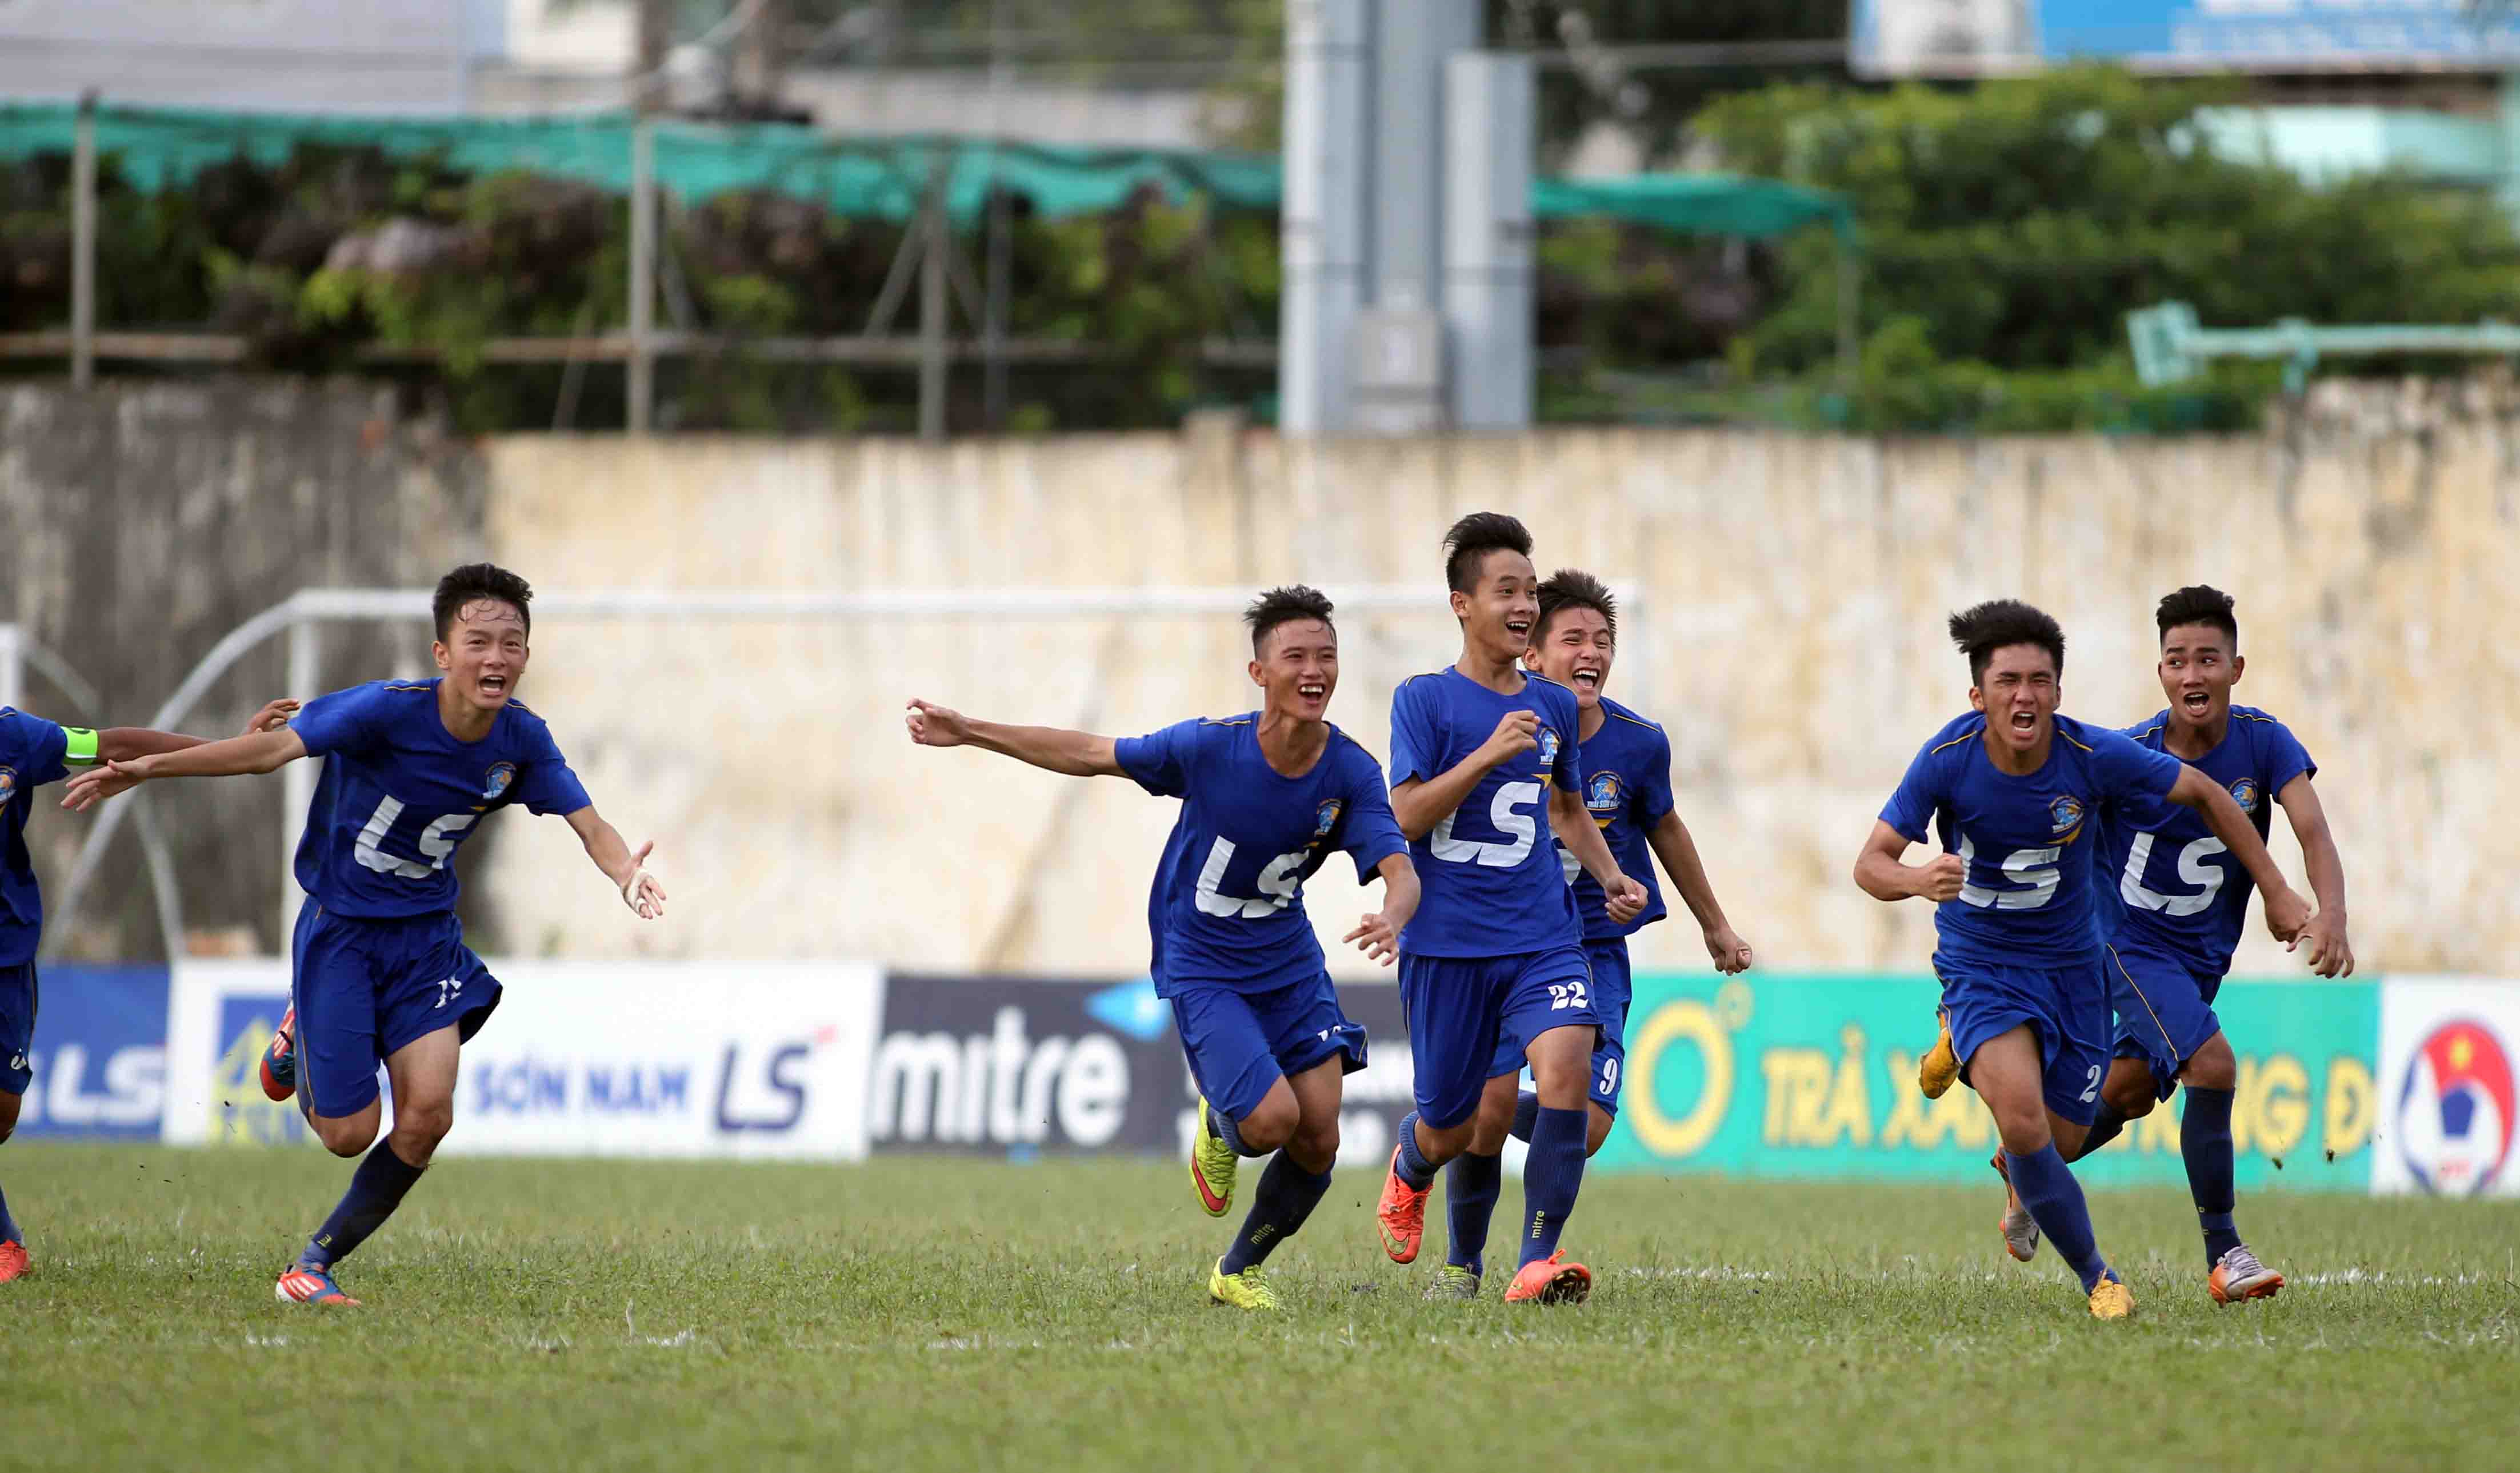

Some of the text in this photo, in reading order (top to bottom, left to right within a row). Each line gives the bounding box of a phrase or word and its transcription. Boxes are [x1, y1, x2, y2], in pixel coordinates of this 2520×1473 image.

[354, 794, 476, 879] LS
[1430, 781, 1541, 868] LS
[1195, 835, 1310, 919] LS
[1957, 832, 2062, 909] LS
[2120, 832, 2228, 916] LS
[1547, 981, 1589, 1011] 22
[715, 1042, 811, 1133] LS
[869, 1005, 1129, 1147] mitre
[1599, 1057, 1618, 1096] 9
[2079, 1064, 2102, 1103] 2
[1531, 1209, 1545, 1239] mitre
